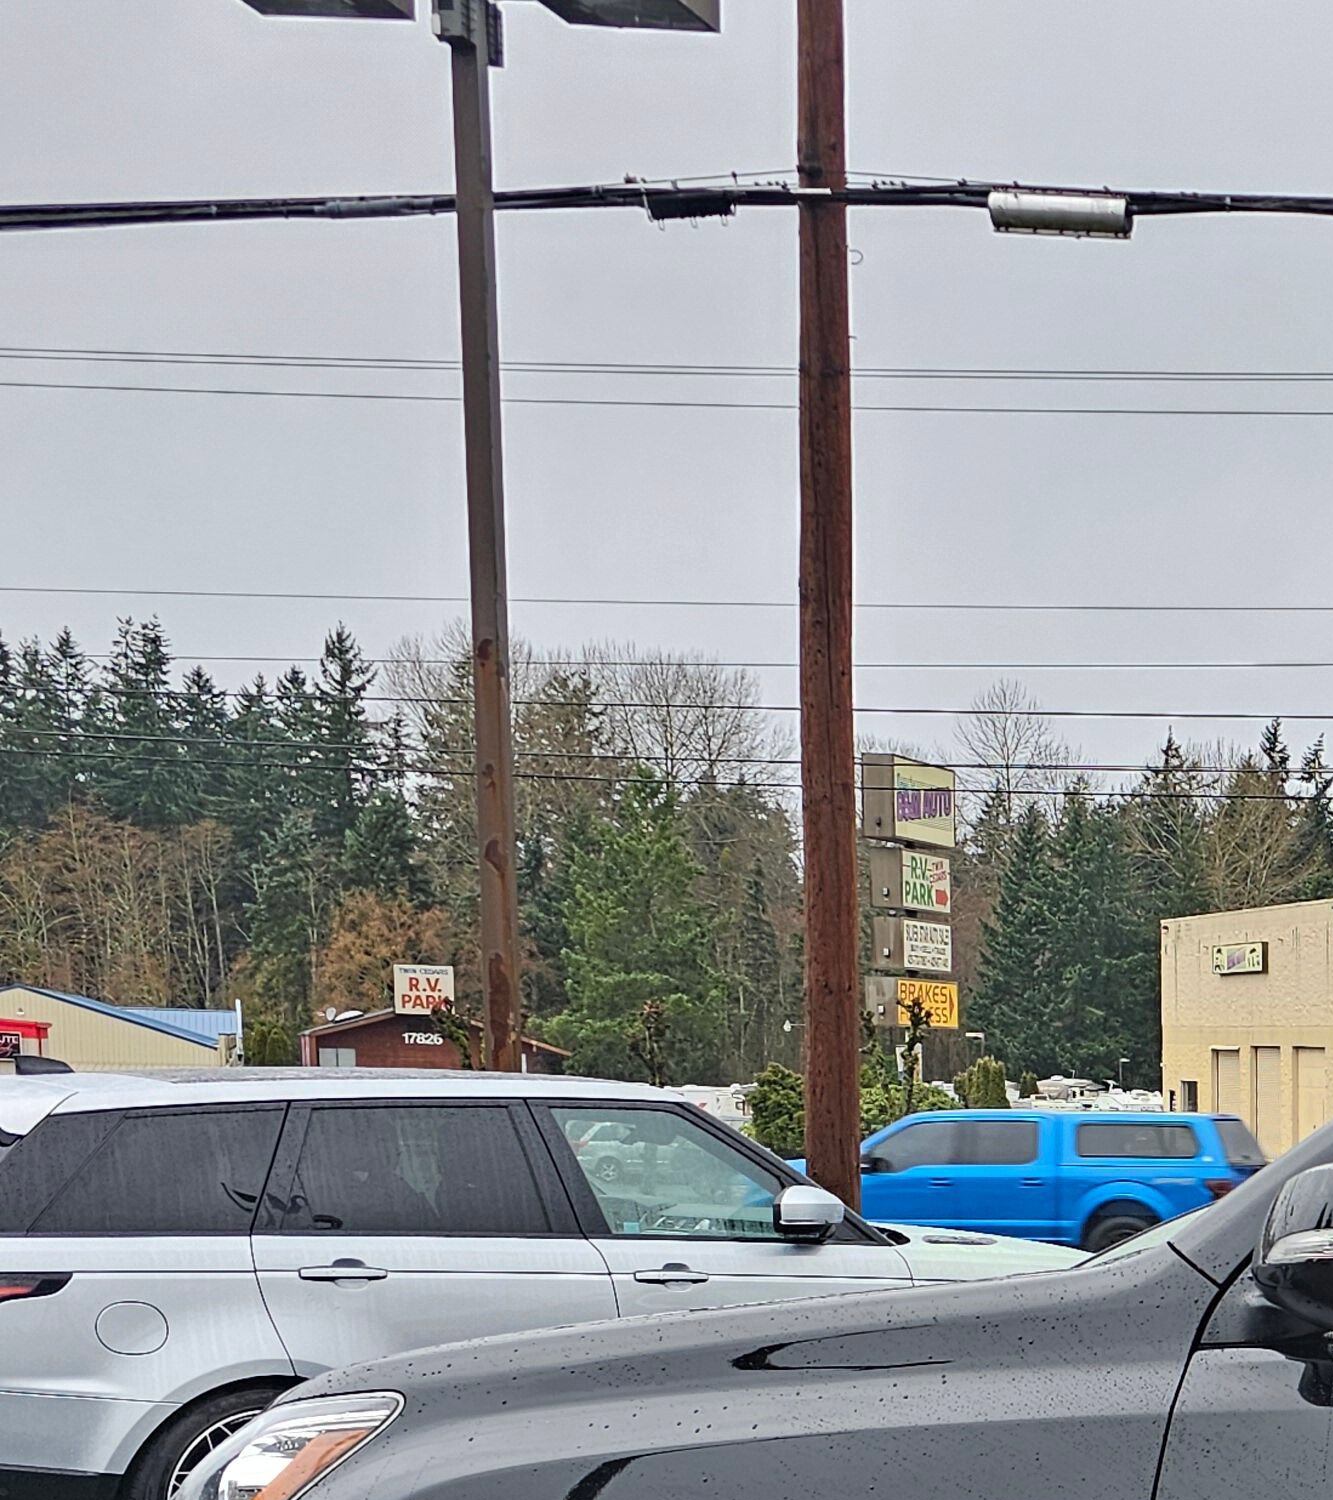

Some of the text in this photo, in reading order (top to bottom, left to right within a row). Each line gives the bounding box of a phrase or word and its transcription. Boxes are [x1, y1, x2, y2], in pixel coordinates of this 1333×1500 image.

[904, 880, 935, 907] PARK
[409, 977, 442, 992] R.V.
[900, 982, 948, 1004] BRAKES
[402, 1032, 444, 1045] 17826
